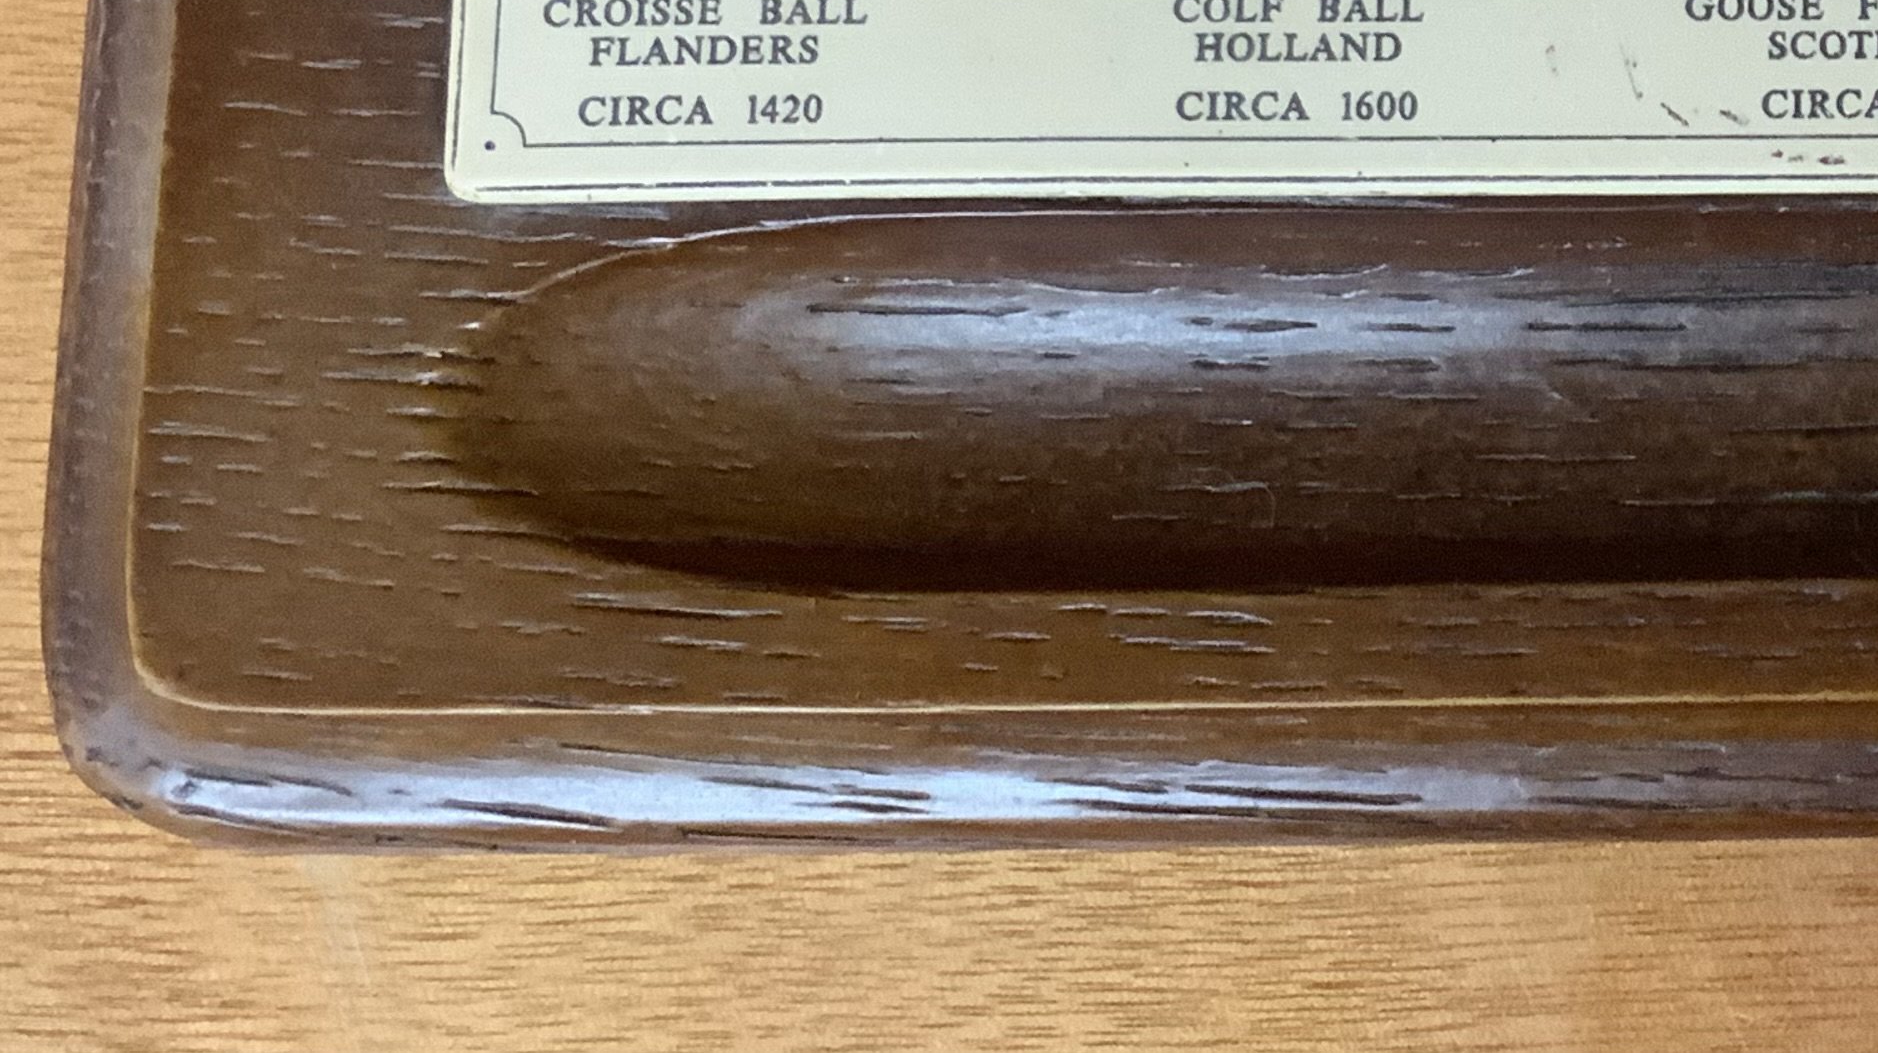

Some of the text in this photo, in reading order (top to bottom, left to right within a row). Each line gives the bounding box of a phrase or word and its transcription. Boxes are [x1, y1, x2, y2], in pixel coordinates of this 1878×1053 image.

[588, 34, 819, 67] FLANDERS
[1194, 31, 1403, 63] HOLLAND
[577, 93, 823, 128] CIRCA 1420
[1175, 90, 1418, 122] CIRCA 1600
